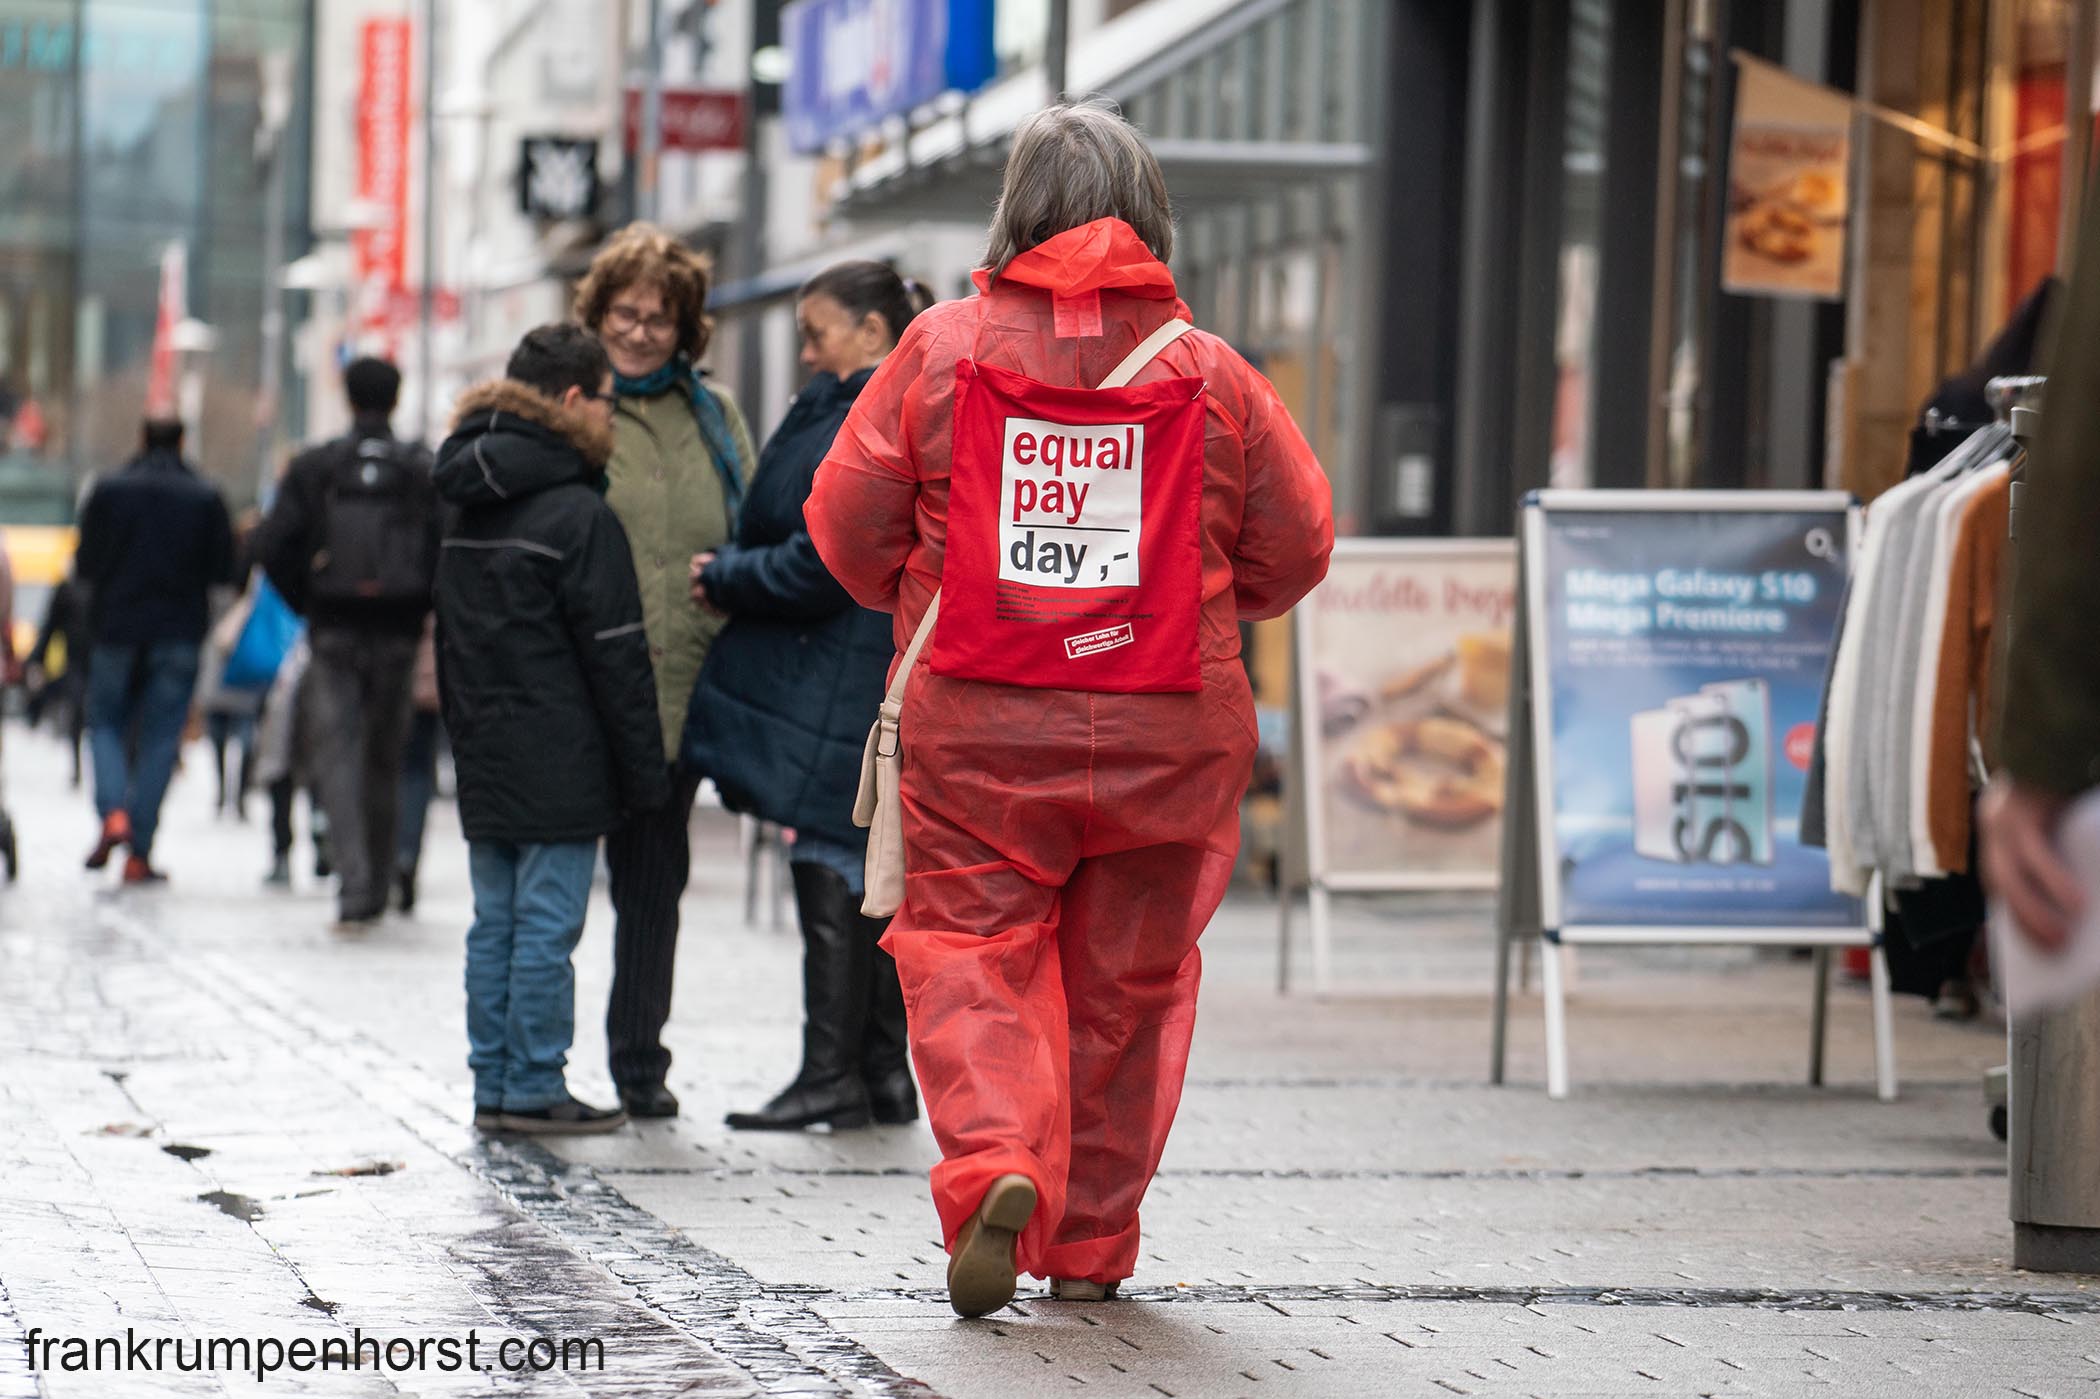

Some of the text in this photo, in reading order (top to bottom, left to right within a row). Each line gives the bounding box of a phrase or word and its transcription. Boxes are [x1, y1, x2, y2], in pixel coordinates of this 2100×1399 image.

[1012, 427, 1135, 476] equal
[1012, 477, 1090, 524] pay
[1010, 531, 1088, 584] day
[1567, 569, 1815, 603] Mega Galaxy S10
[1567, 604, 1785, 635] Mega Premiere
[1669, 715, 1753, 863] S10
